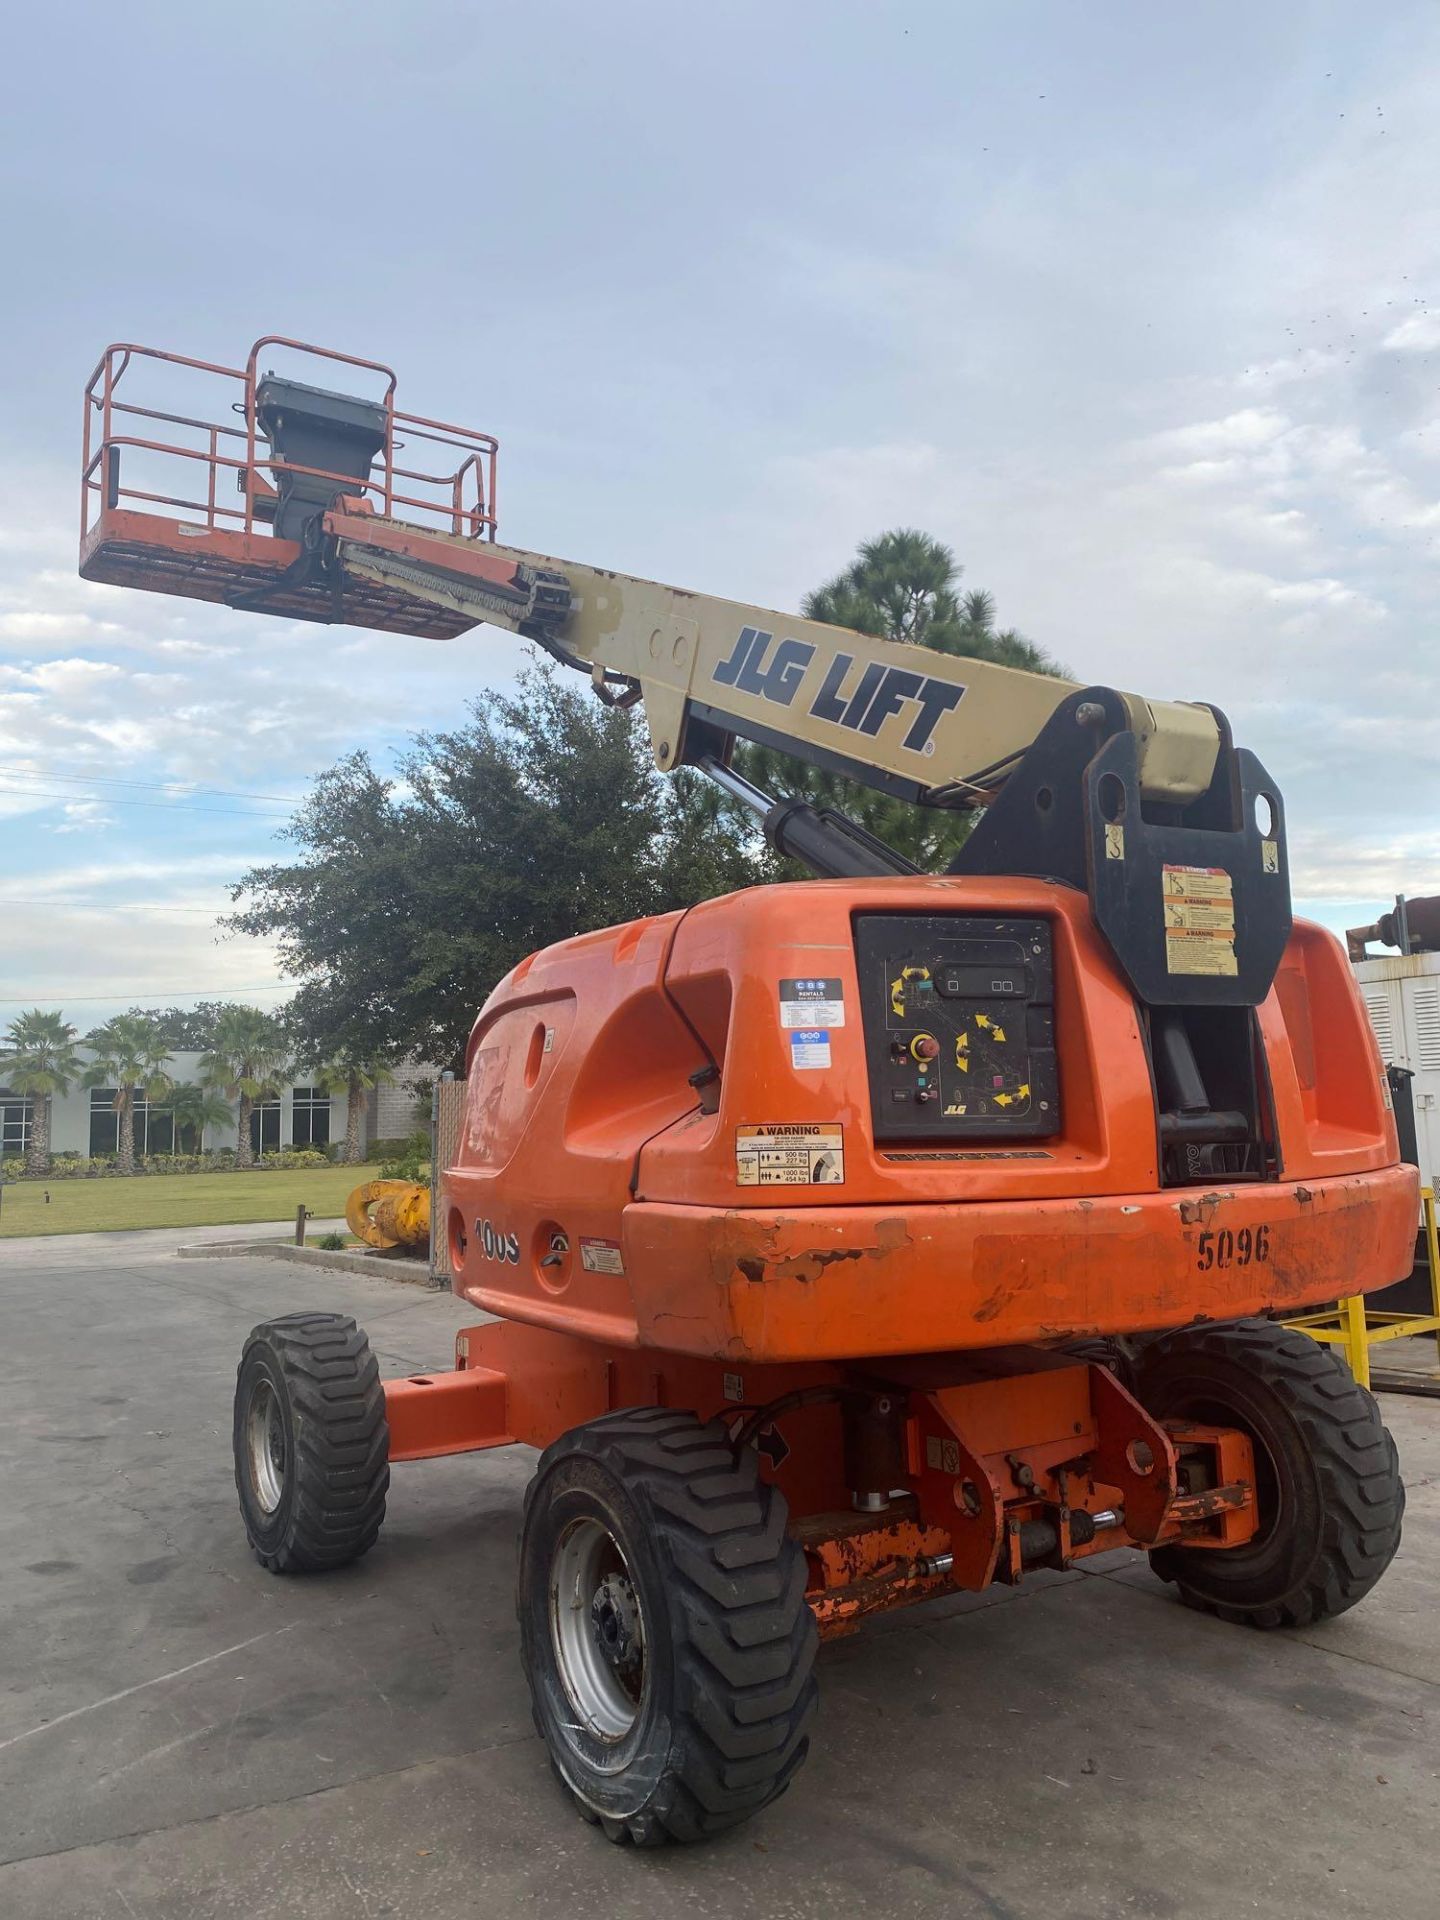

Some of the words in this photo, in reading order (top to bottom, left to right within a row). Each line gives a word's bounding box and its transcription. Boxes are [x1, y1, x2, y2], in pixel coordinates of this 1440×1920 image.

[712, 626, 817, 706] JLG
[809, 653, 967, 752] LIFT
[797, 981, 825, 989] CBS
[943, 1104, 967, 1115] JLG
[767, 1126, 820, 1135] WARNING
[1197, 1224, 1270, 1271] 5096
